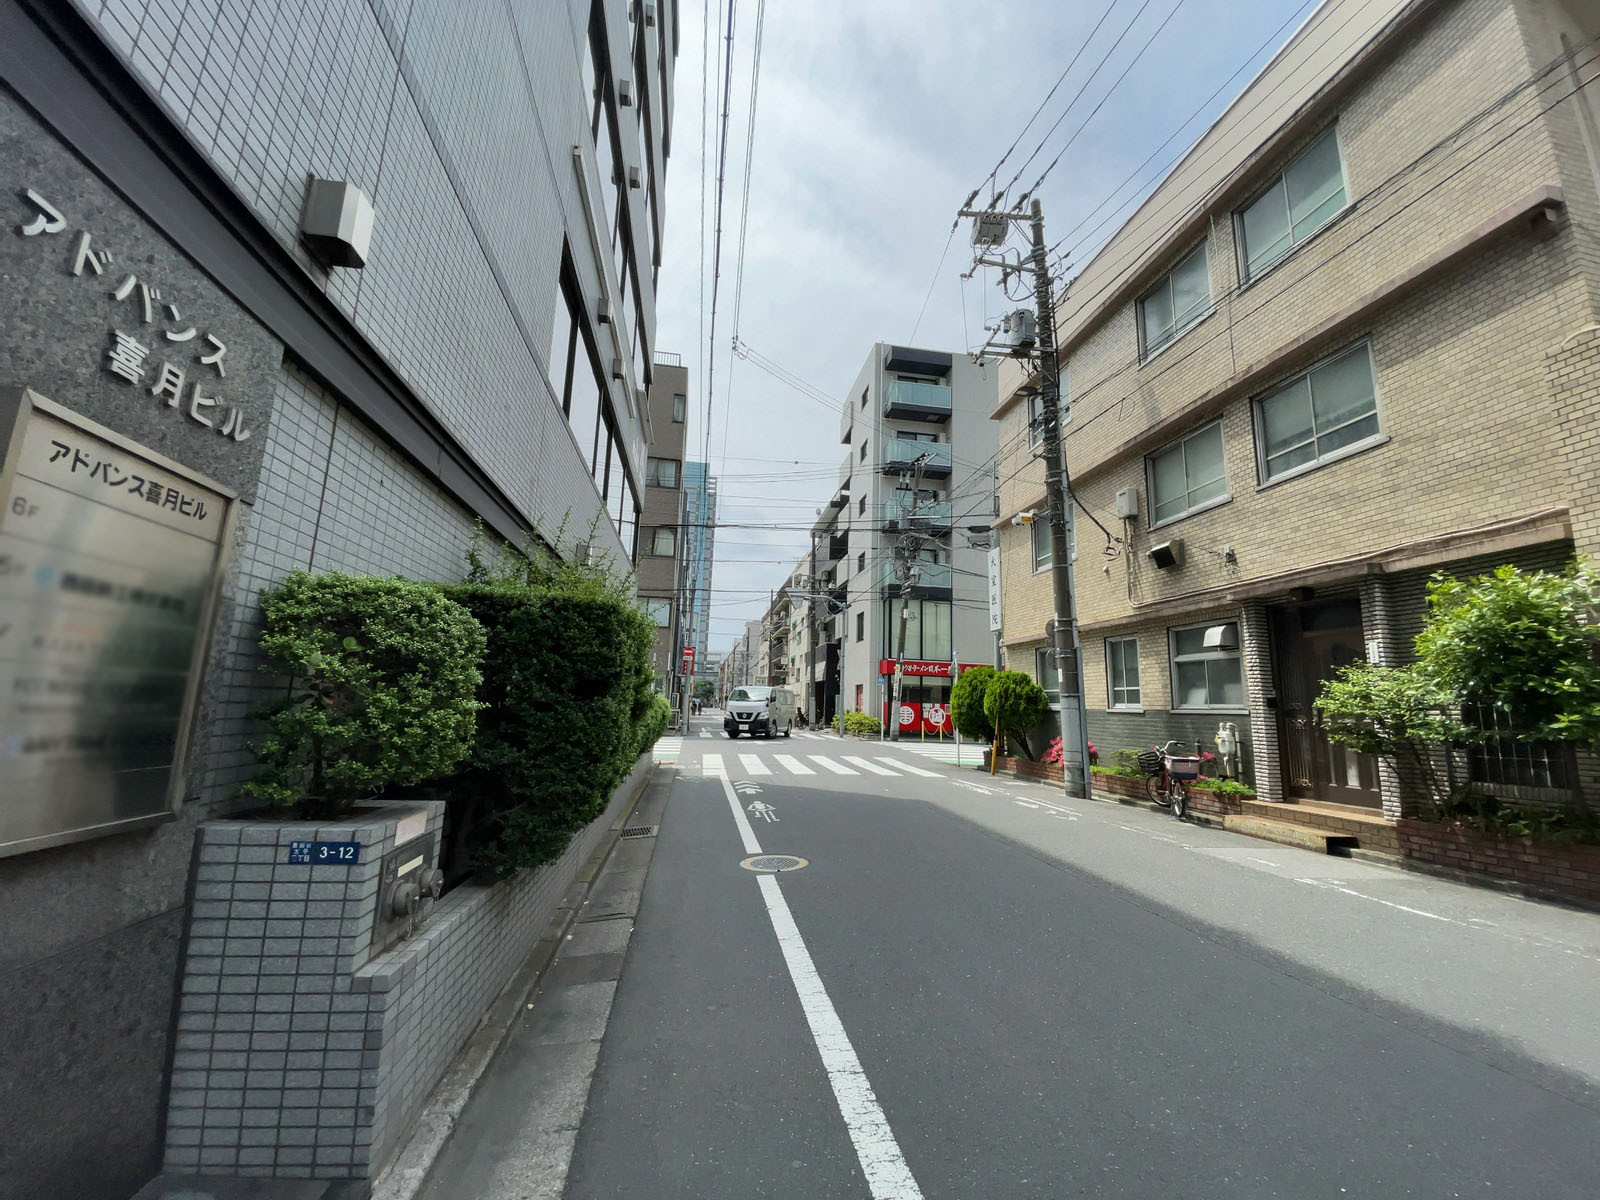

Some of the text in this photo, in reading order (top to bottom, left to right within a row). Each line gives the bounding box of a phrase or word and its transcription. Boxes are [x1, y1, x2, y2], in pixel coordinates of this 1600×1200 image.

[22, 188, 228, 378] アドバンス
[108, 328, 251, 442] 喜月ビル
[11, 495, 40, 518] 6F
[48, 439, 208, 521] アドバンス喜月ビル
[319, 846, 354, 859] 3-12
